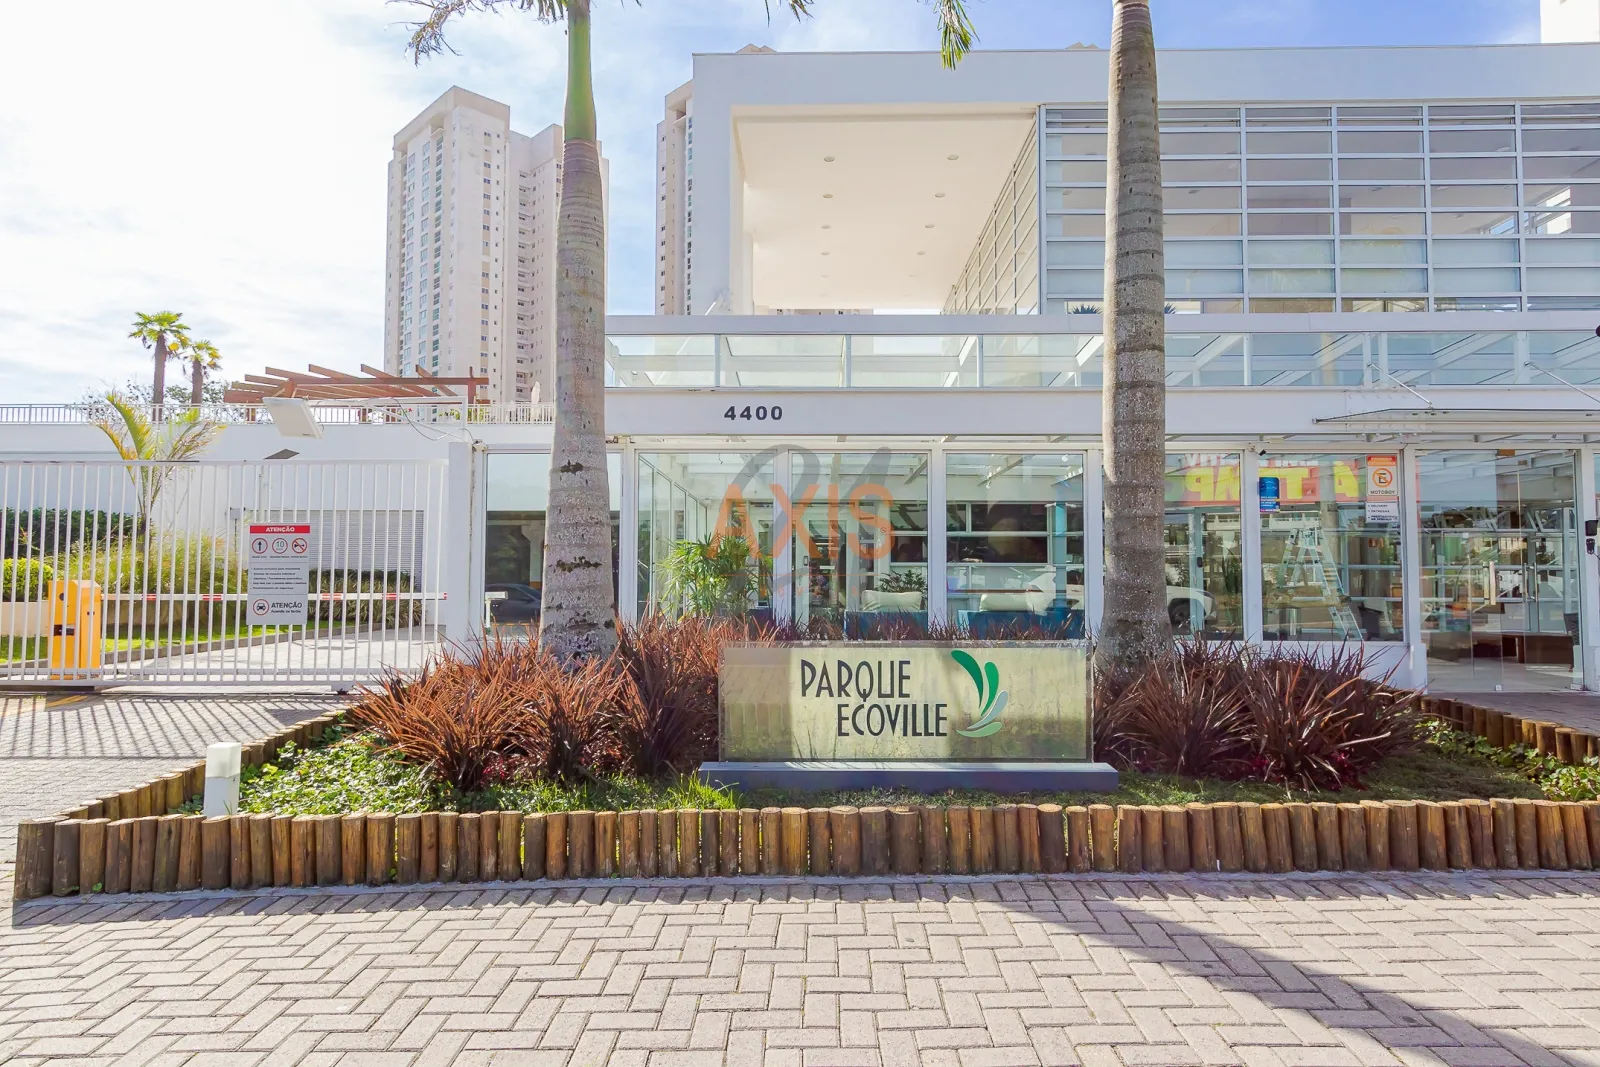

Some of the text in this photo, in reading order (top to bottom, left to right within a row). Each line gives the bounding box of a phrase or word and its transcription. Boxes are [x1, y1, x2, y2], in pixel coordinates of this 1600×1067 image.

[724, 405, 783, 421] 4400
[800, 659, 911, 703] PARQUE
[837, 703, 948, 737] ECOVILLE
